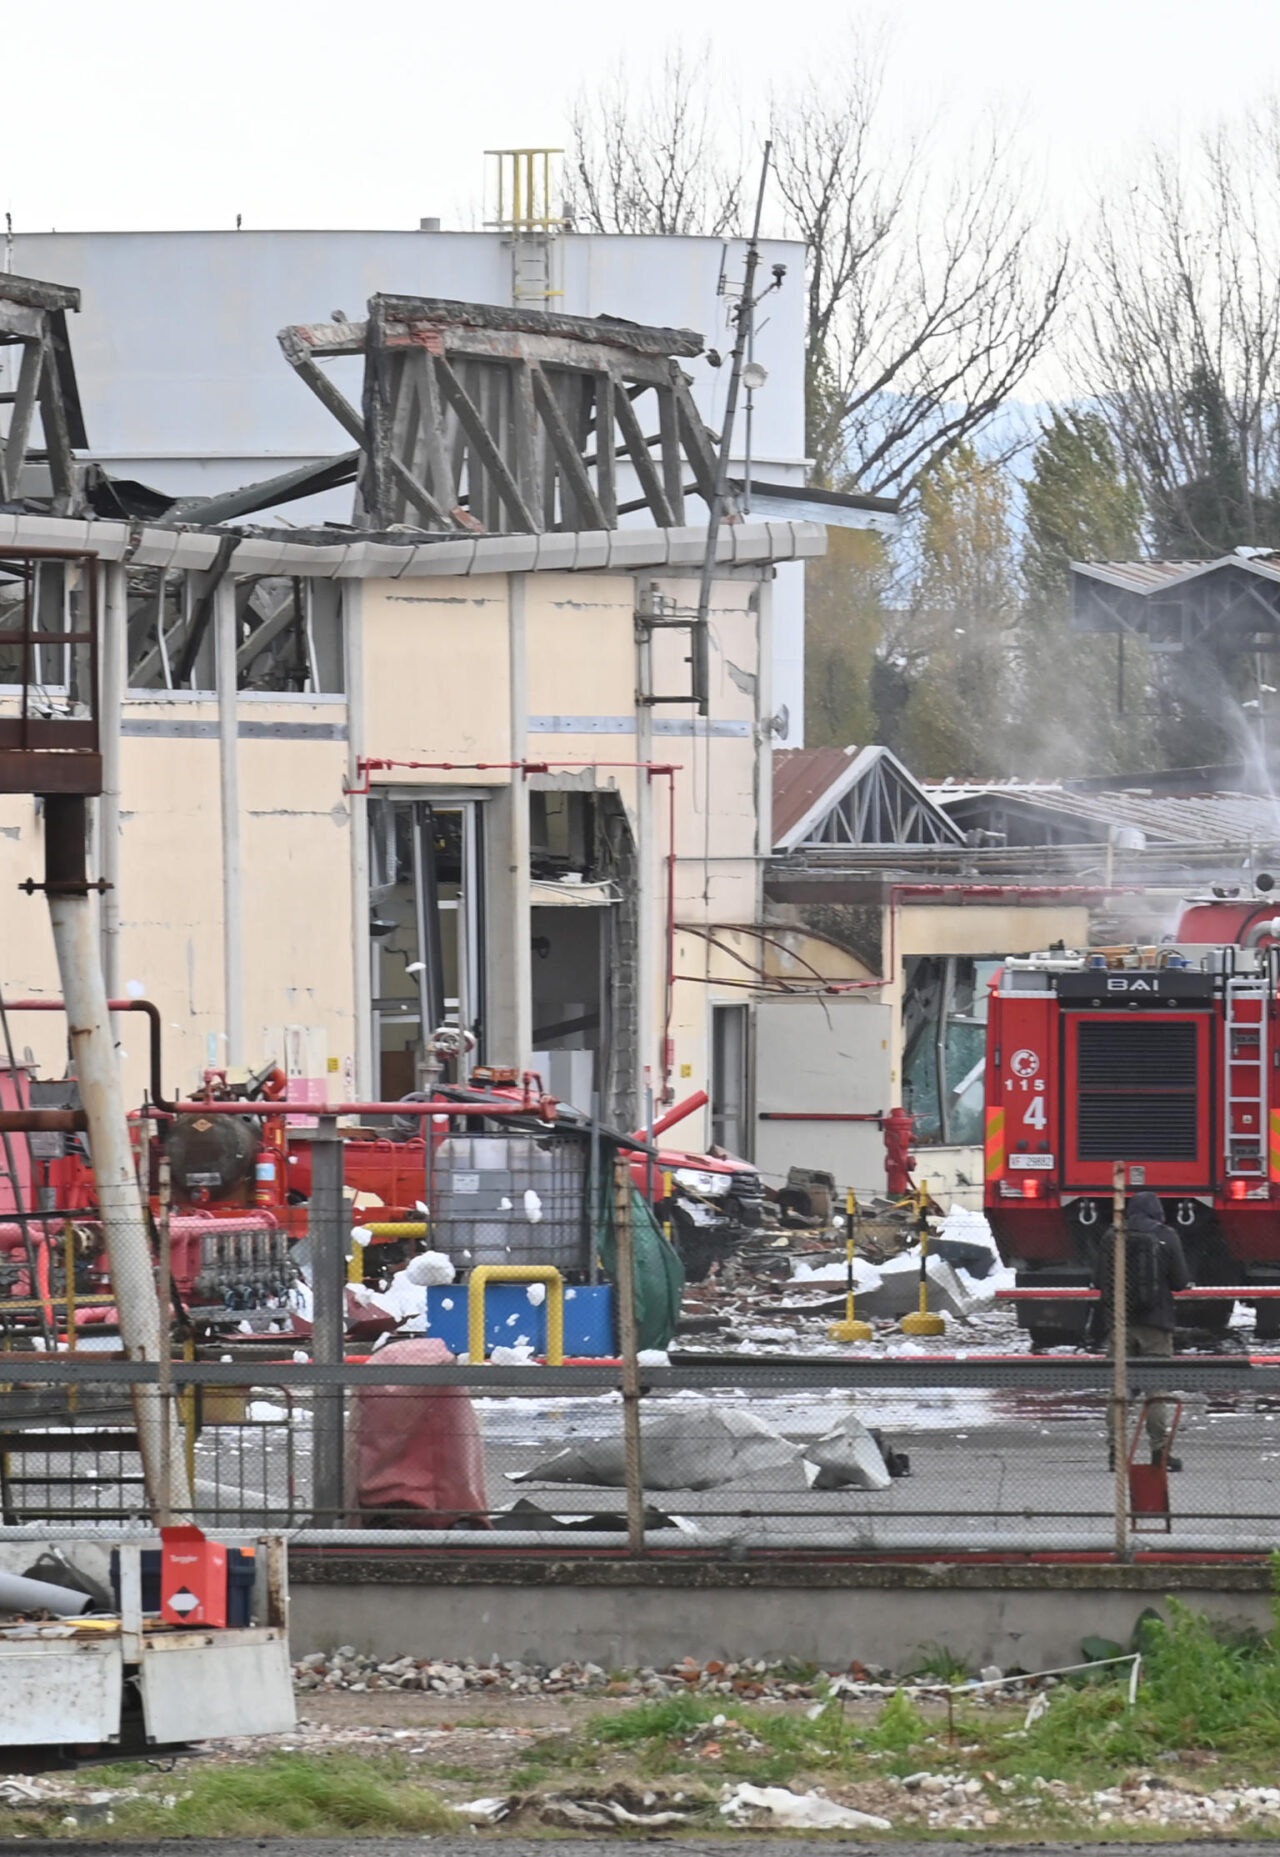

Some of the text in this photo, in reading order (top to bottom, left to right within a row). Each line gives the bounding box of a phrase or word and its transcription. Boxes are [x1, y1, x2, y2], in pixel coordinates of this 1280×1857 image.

[1107, 979, 1159, 991] BAI
[1004, 1079, 1045, 1091] 115
[1023, 1096, 1047, 1130] 4
